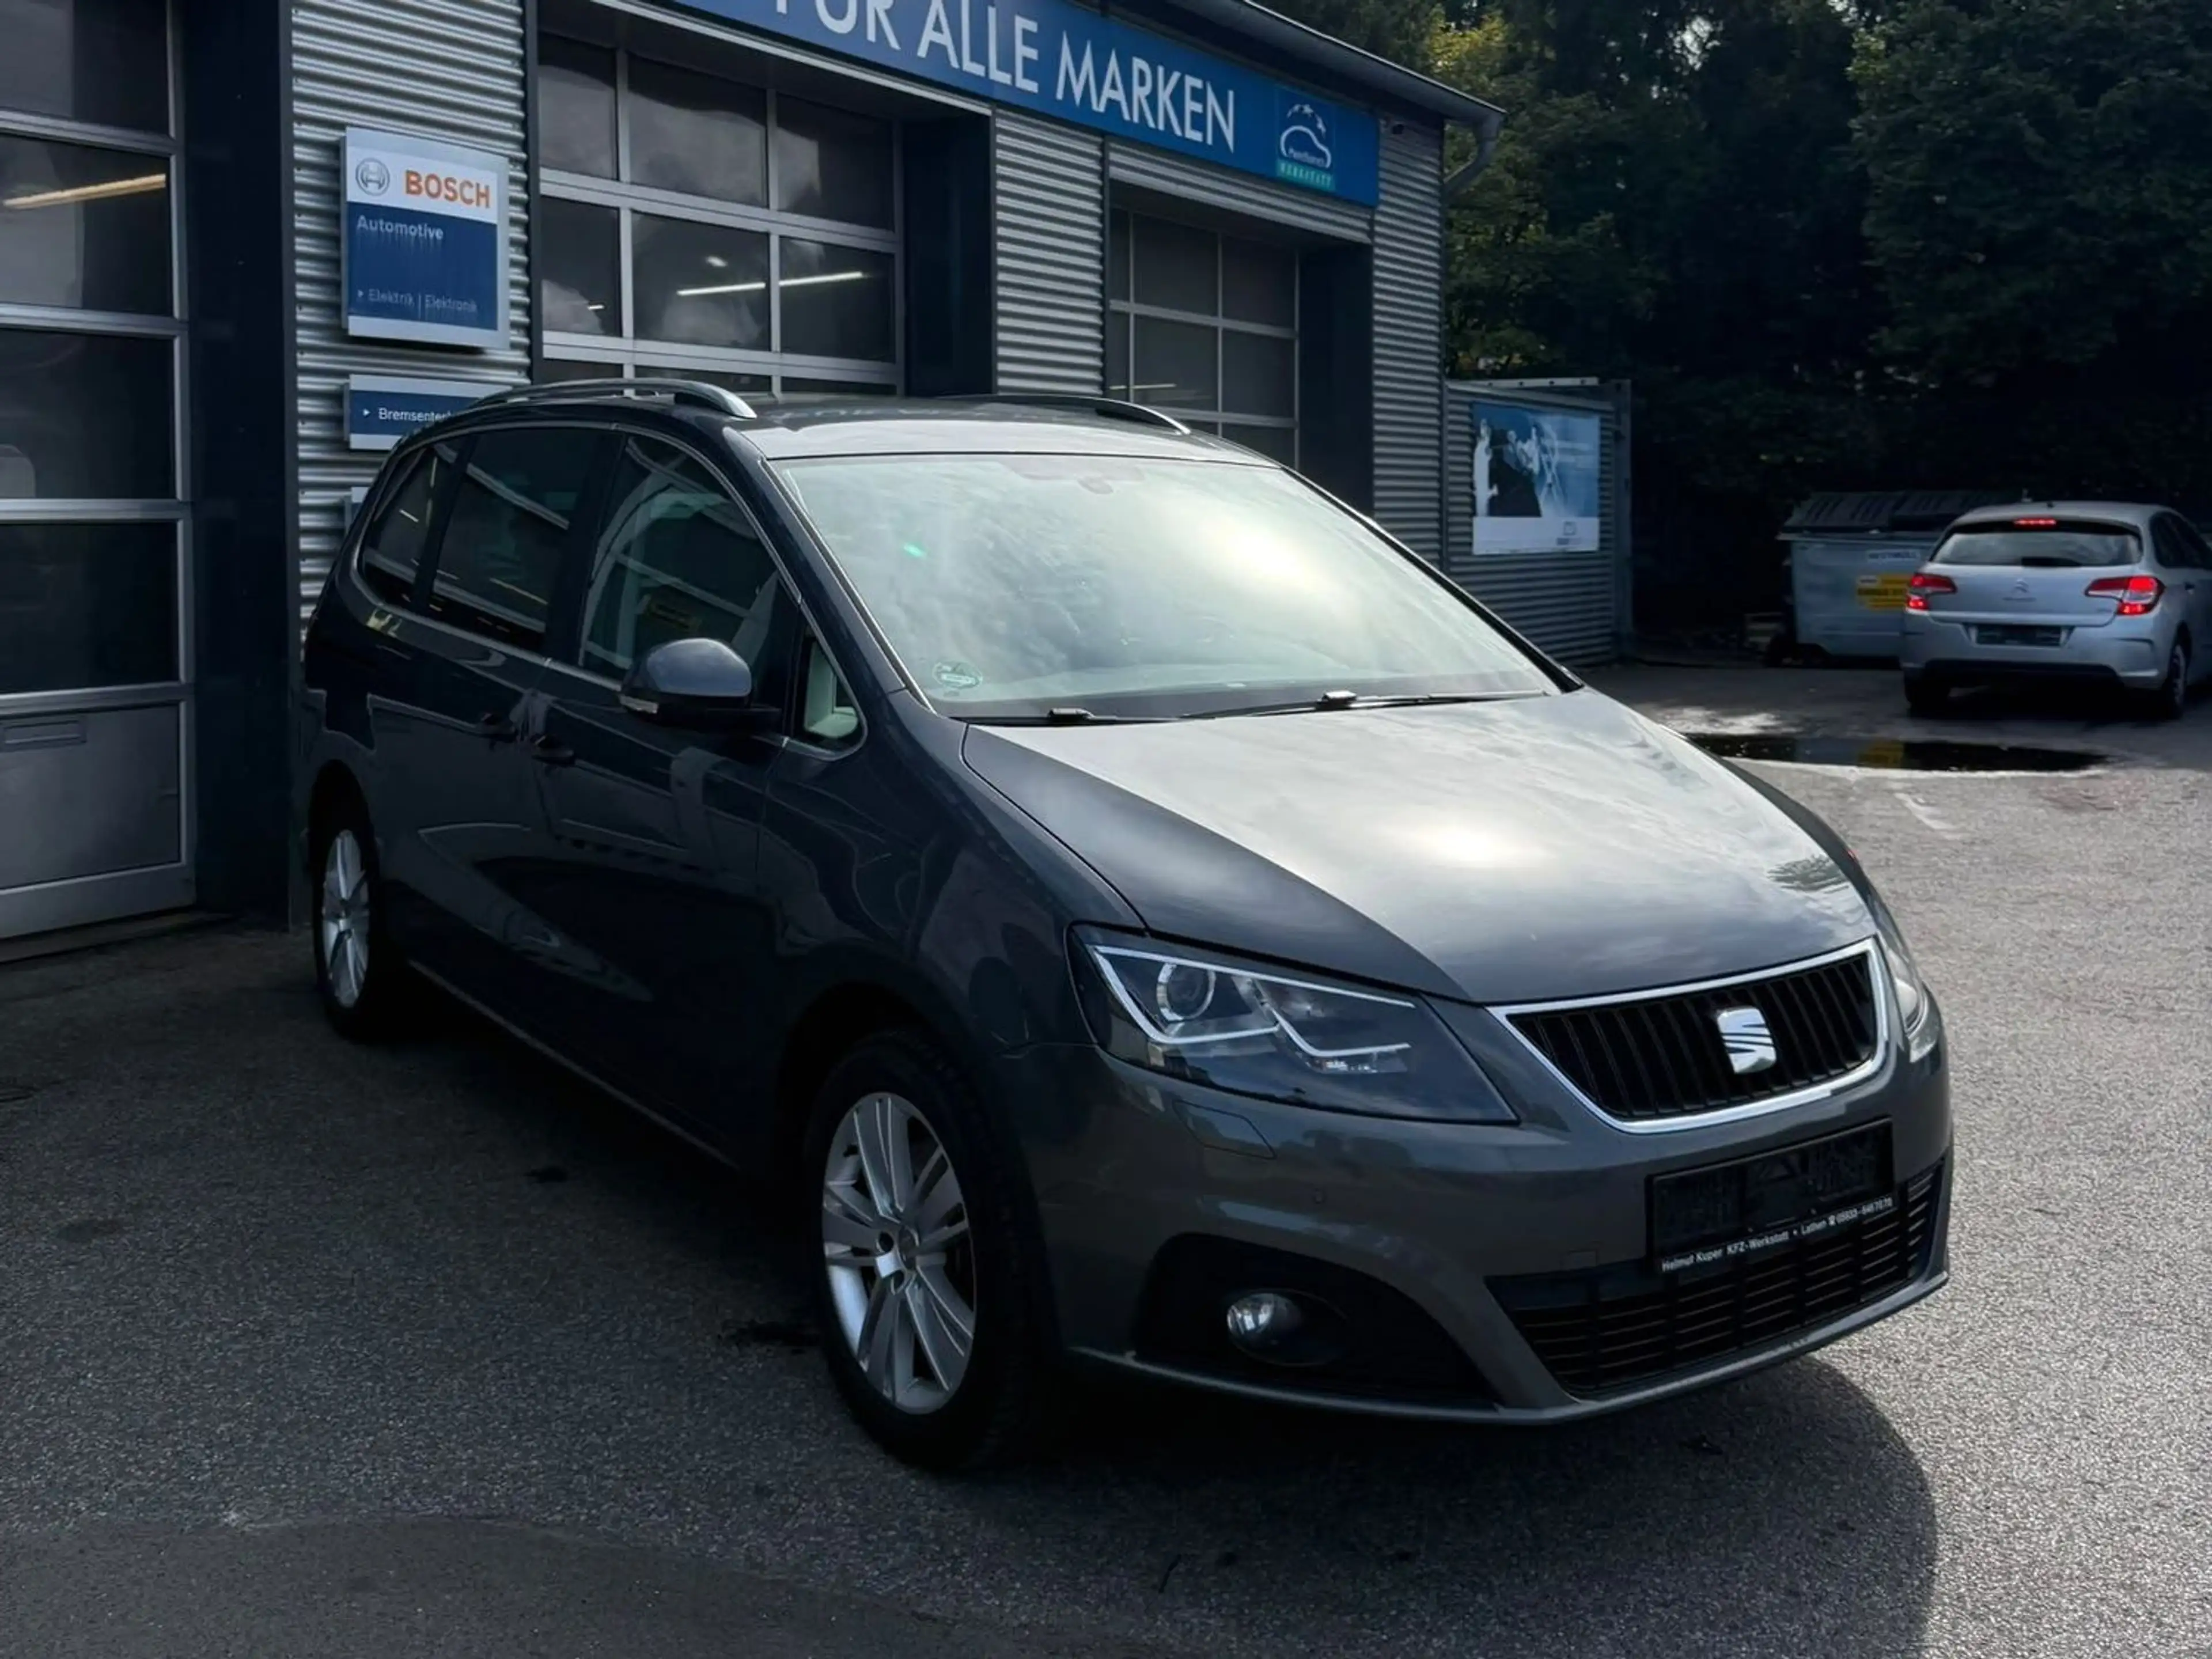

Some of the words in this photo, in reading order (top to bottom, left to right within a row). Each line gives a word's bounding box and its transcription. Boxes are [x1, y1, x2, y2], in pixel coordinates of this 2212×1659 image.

[917, 0, 1039, 93] ALLE
[1056, 30, 1234, 154] MARKEN
[405, 170, 490, 208] BOSCH
[357, 215, 444, 241] Automotive
[368, 289, 415, 306] Elektrik
[425, 294, 478, 313] Elektronik
